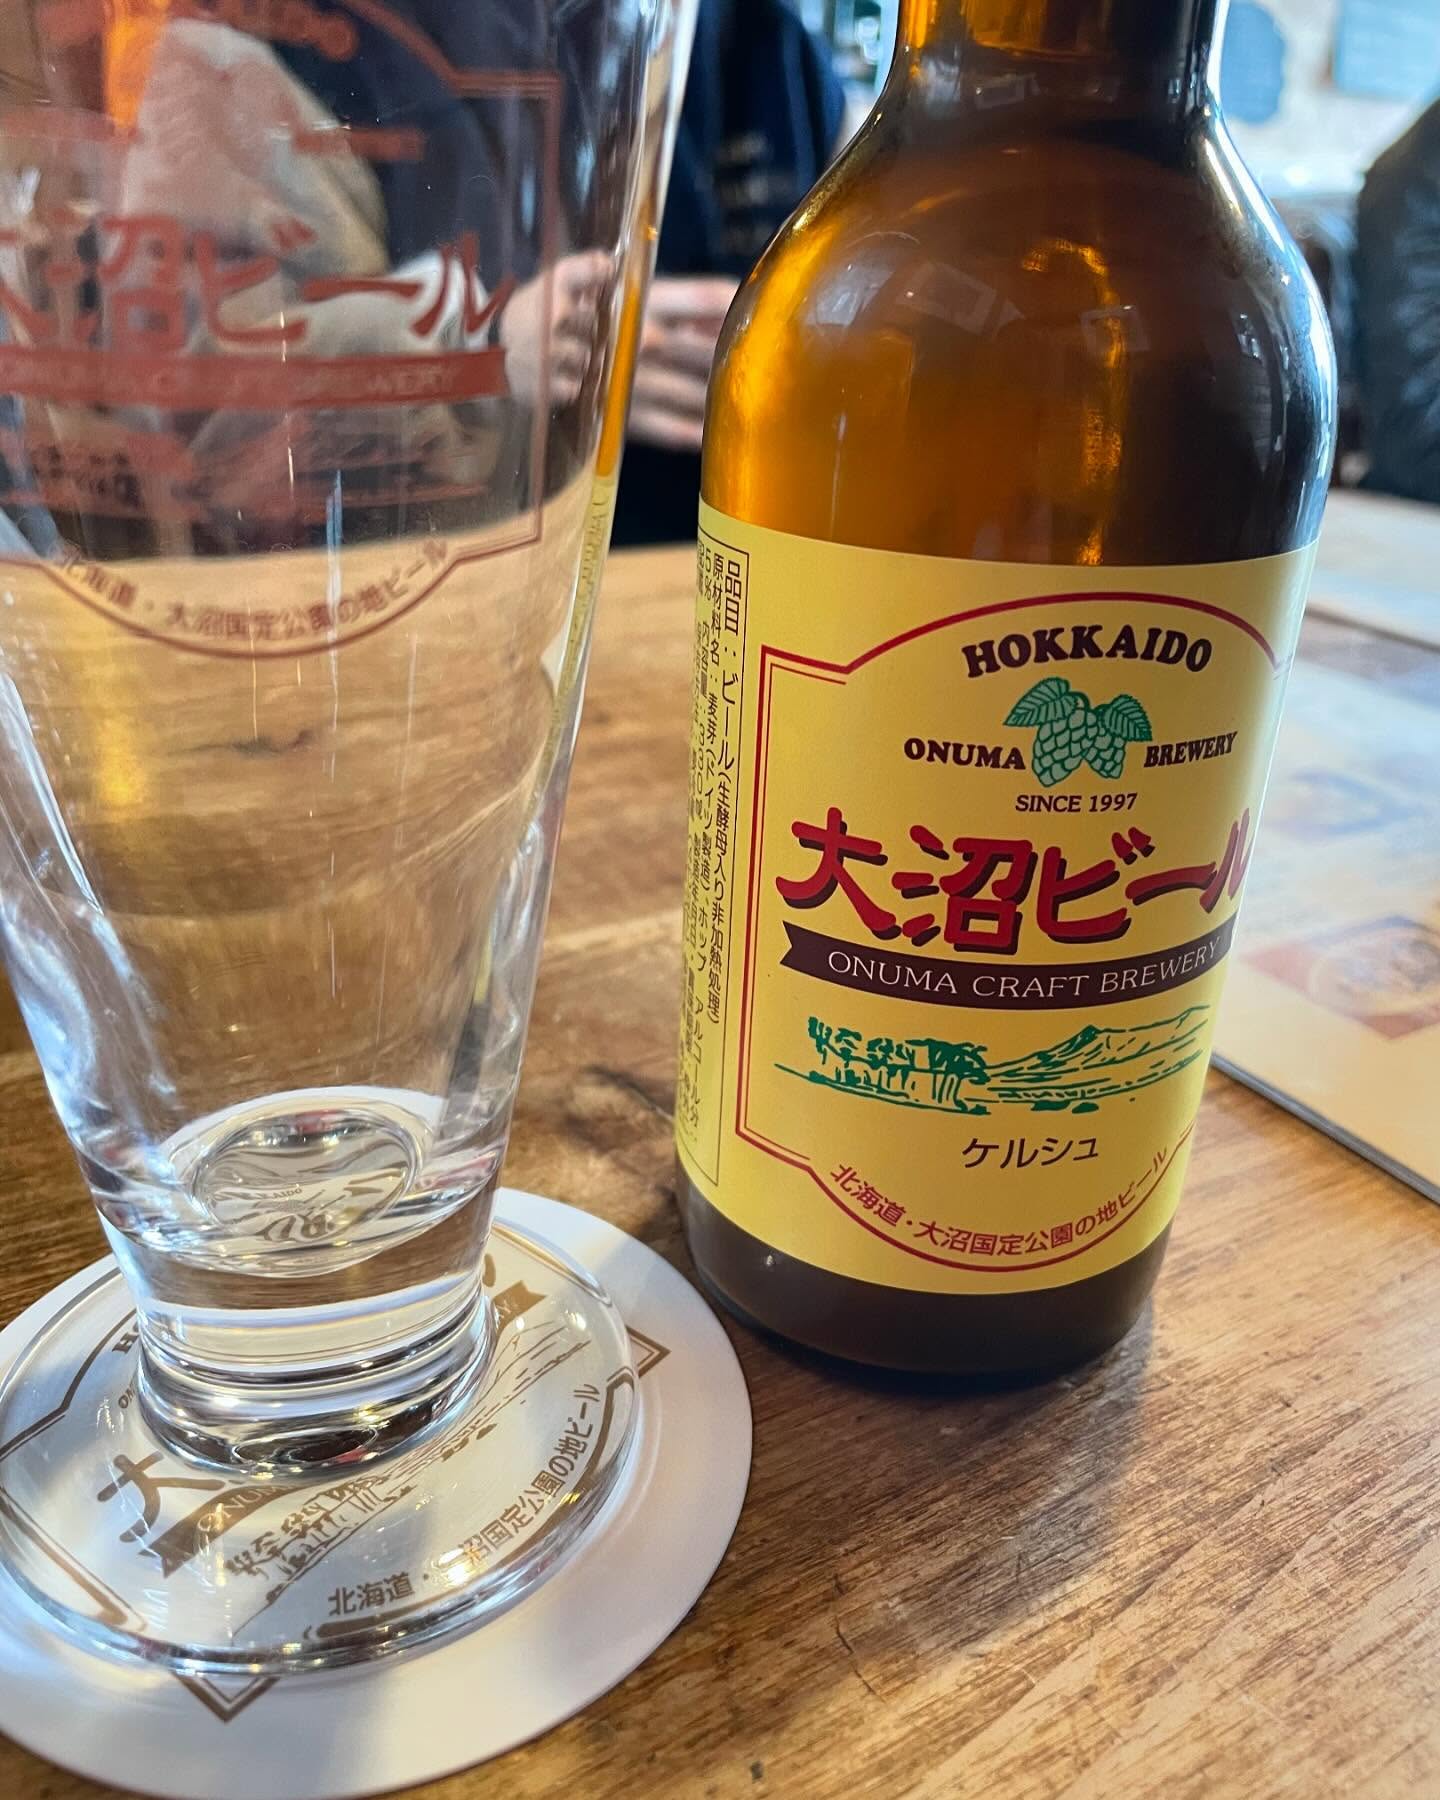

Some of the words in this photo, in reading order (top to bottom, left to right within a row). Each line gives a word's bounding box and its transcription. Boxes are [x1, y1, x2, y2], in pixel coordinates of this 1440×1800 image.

[961, 624, 1213, 678] HOKKAIDO
[904, 738, 1026, 770] ONUMA
[1143, 731, 1237, 768] BREWERY
[1015, 794, 1081, 813] SINCE
[1088, 792, 1138, 813] 1997
[776, 807, 1253, 955] 大沼ビール
[828, 950, 958, 995] ONUMA
[973, 973, 1090, 999] CRAFT
[1100, 936, 1222, 994] BREWERY
[961, 1136, 1099, 1169] ケルシュ
[830, 1147, 1168, 1258] 北海道・大沼国定公園の地ビール
[328, 1383, 600, 1616] 北海道・沼国定公園の地ビール
